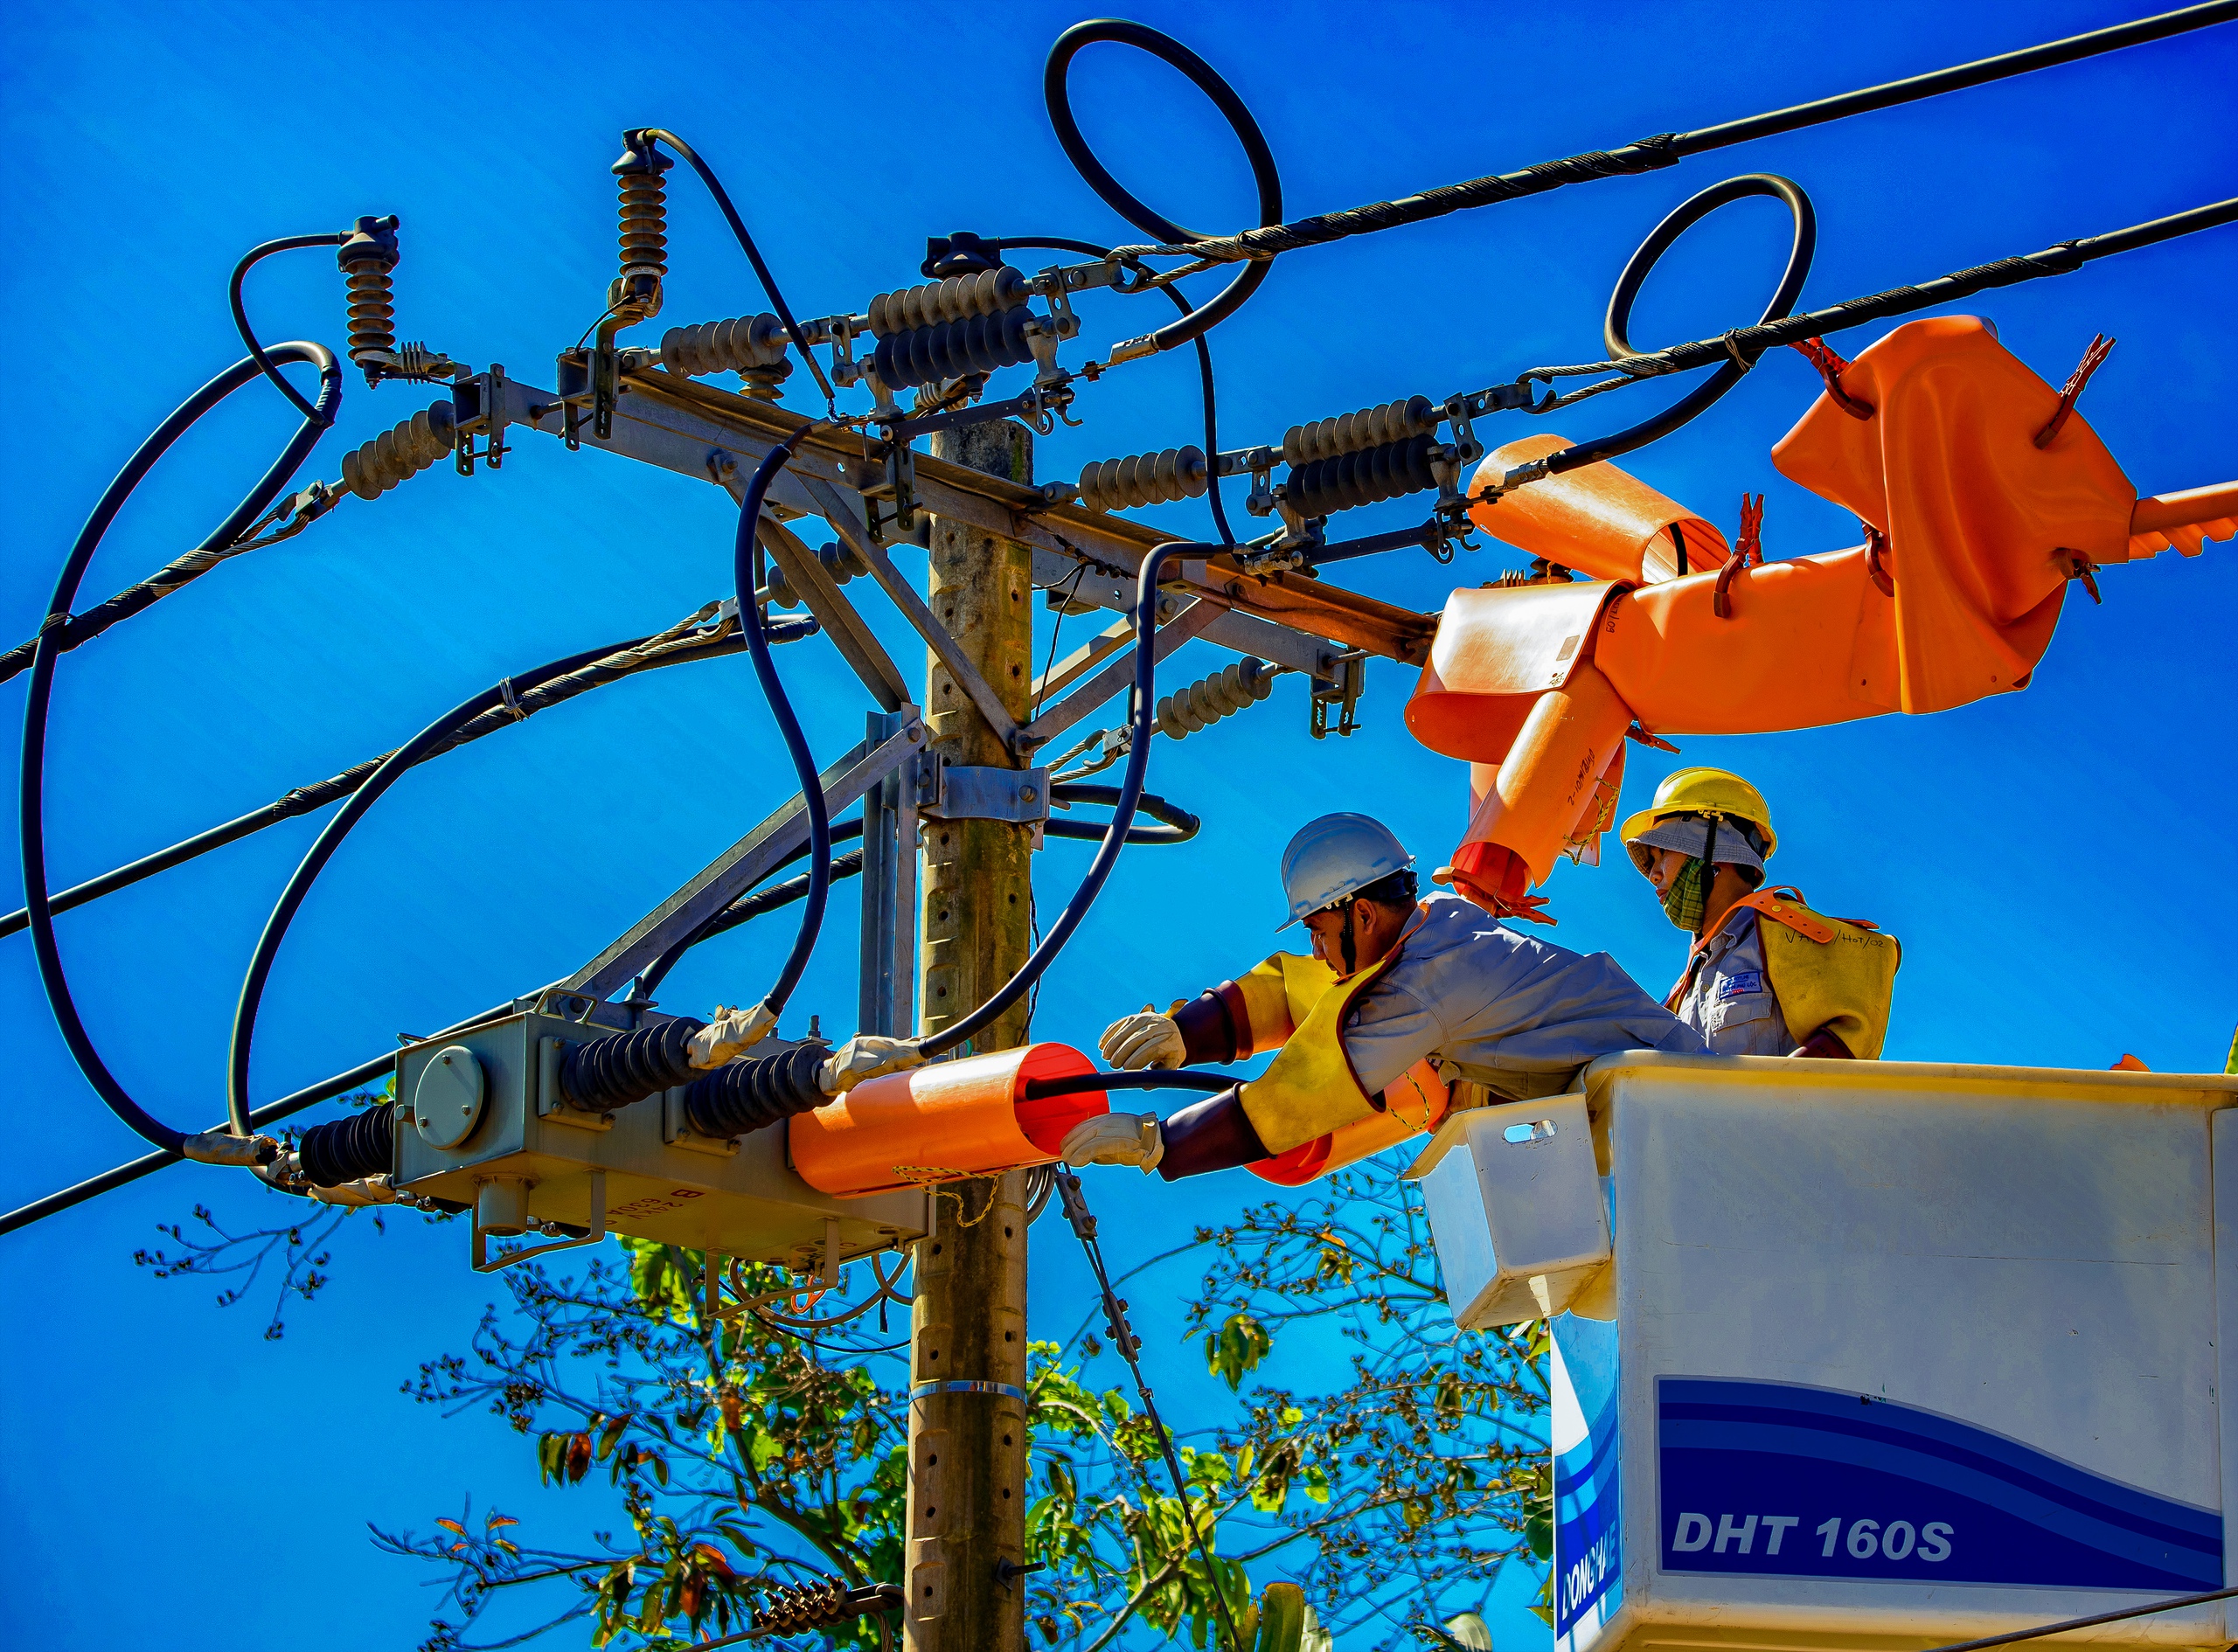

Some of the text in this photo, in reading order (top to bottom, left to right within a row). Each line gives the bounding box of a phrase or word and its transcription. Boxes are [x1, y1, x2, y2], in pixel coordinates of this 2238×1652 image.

[1561, 1519, 1616, 1621] DONGHAE
[1672, 1512, 1955, 1562] DHT 160S
